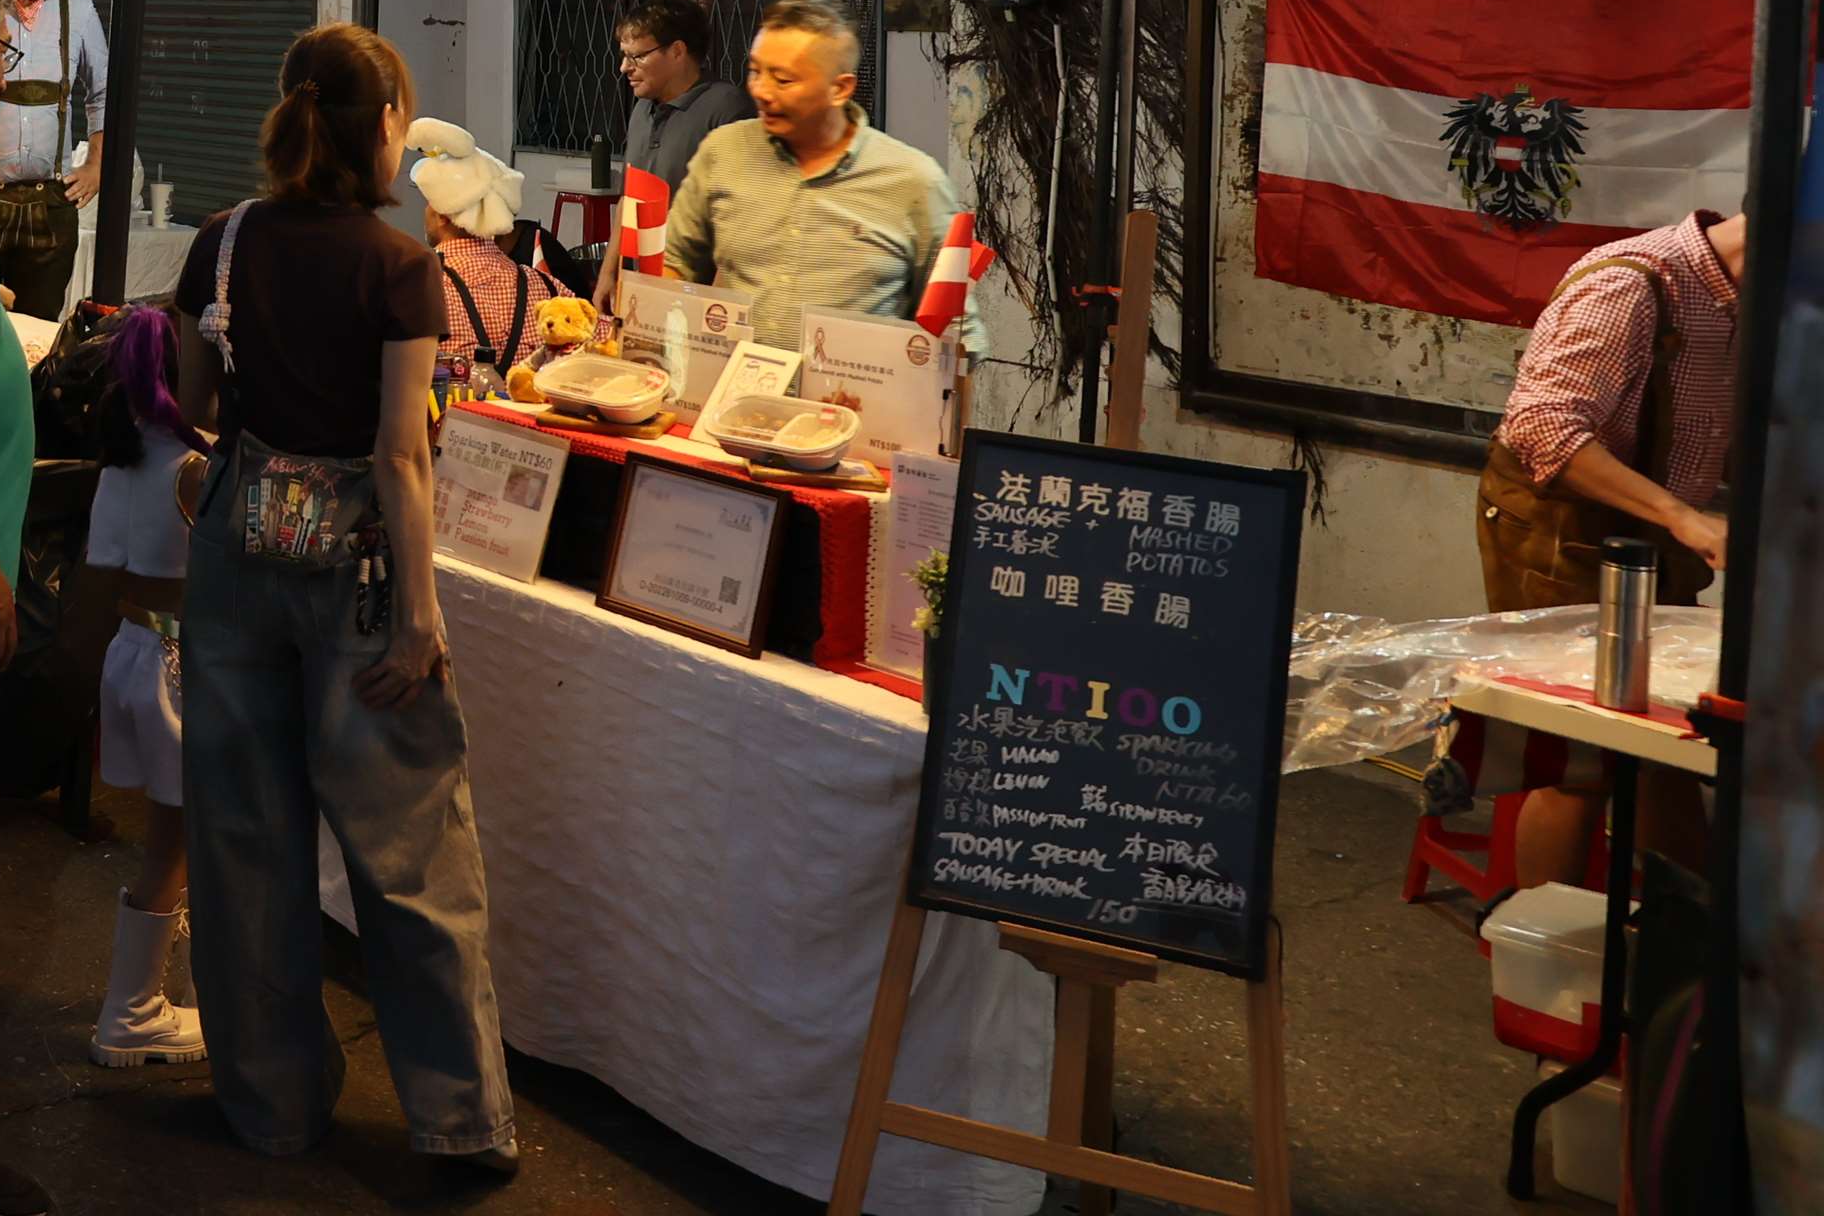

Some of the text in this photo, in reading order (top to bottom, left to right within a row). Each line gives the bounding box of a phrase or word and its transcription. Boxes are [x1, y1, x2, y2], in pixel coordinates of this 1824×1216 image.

[973, 499, 1072, 529] SAUSAGE
[1128, 524, 1233, 555] MASHED
[995, 469, 1241, 537] 法蘭克福香腸
[990, 565, 1192, 630] 咖哩香腸
[992, 771, 1051, 792] LEMON
[937, 832, 1116, 872] TODAY SPECIAL
